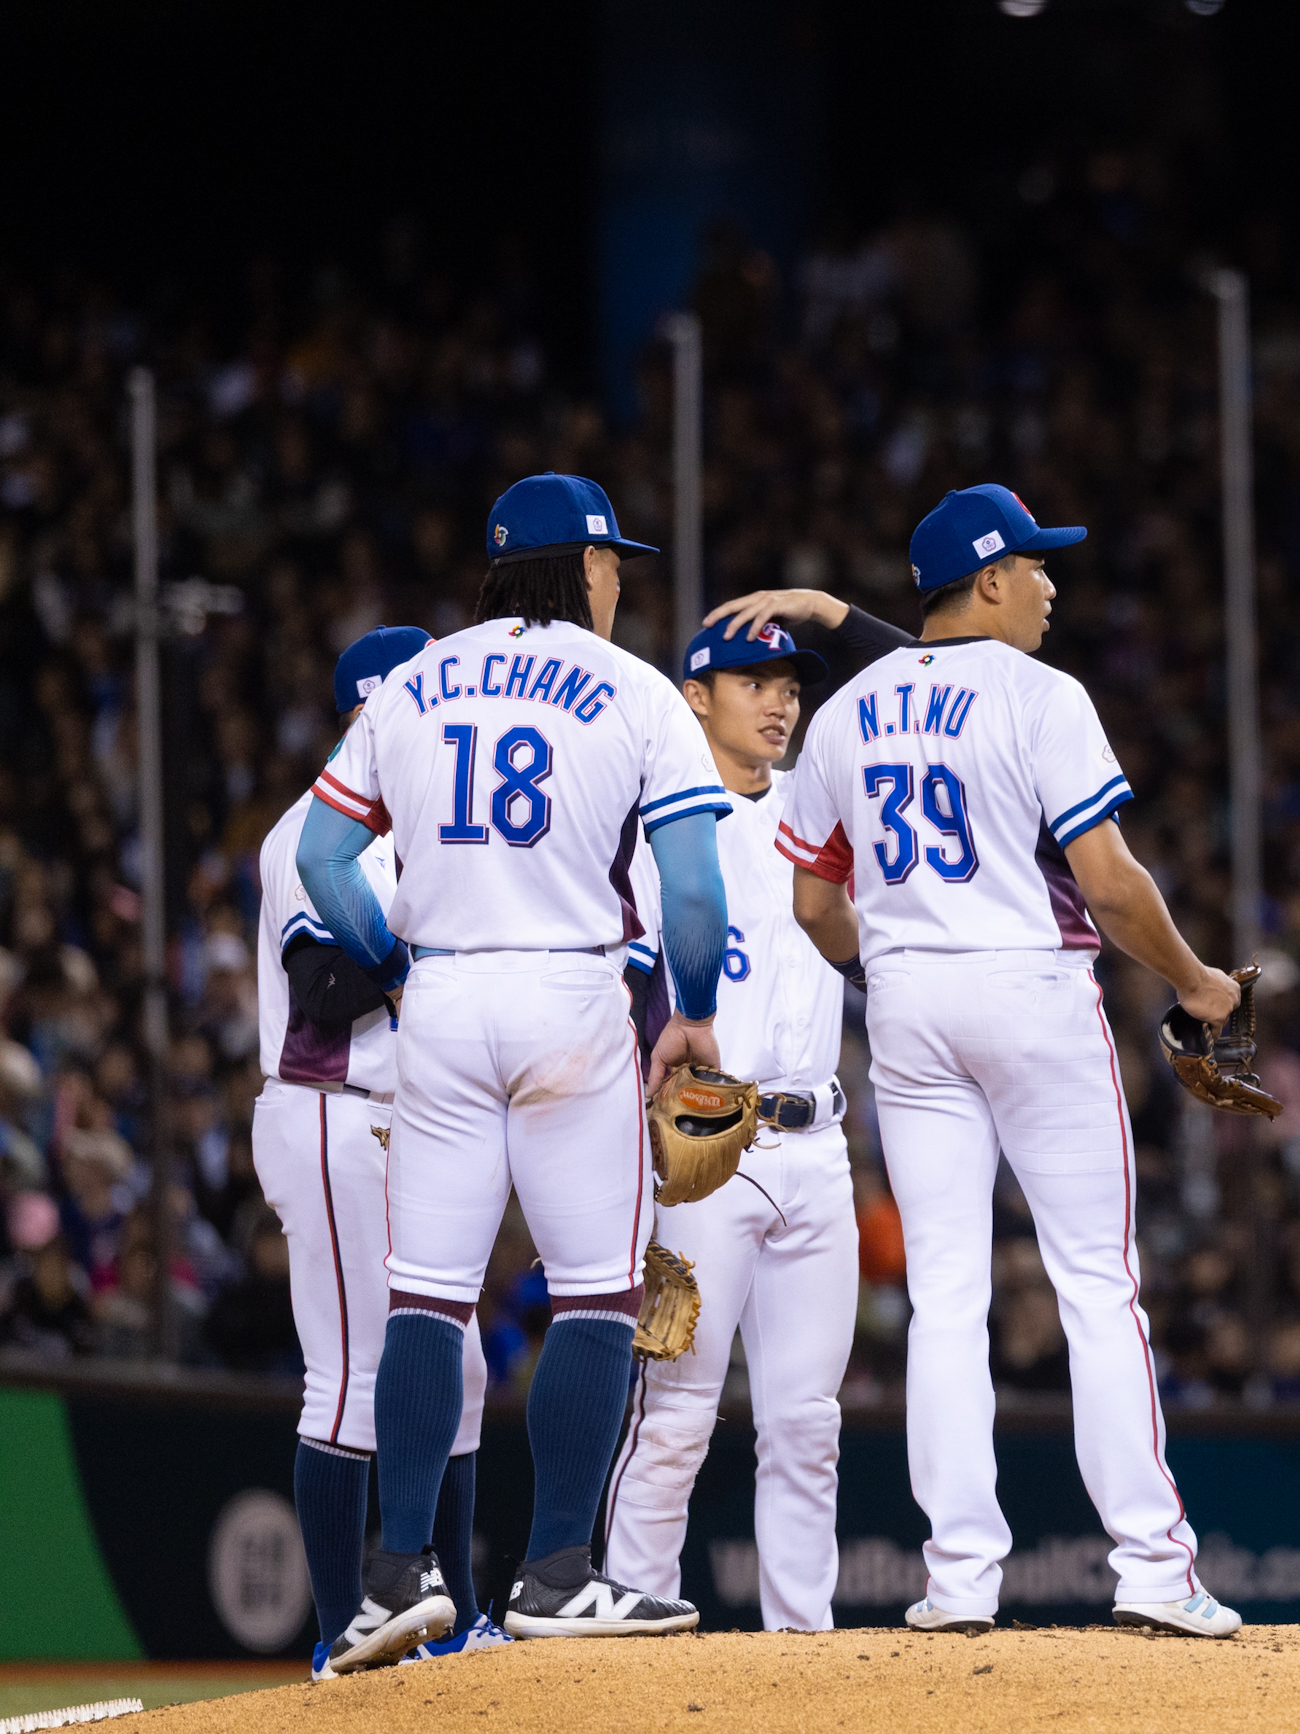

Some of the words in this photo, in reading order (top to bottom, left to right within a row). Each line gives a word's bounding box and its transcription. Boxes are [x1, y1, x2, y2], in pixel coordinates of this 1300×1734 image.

[403, 653, 617, 726] Y.C.CHANG
[857, 683, 979, 745] N.T.WU
[438, 722, 553, 848] 18
[861, 762, 980, 886] 39
[682, 1089, 720, 1107] Wilson
